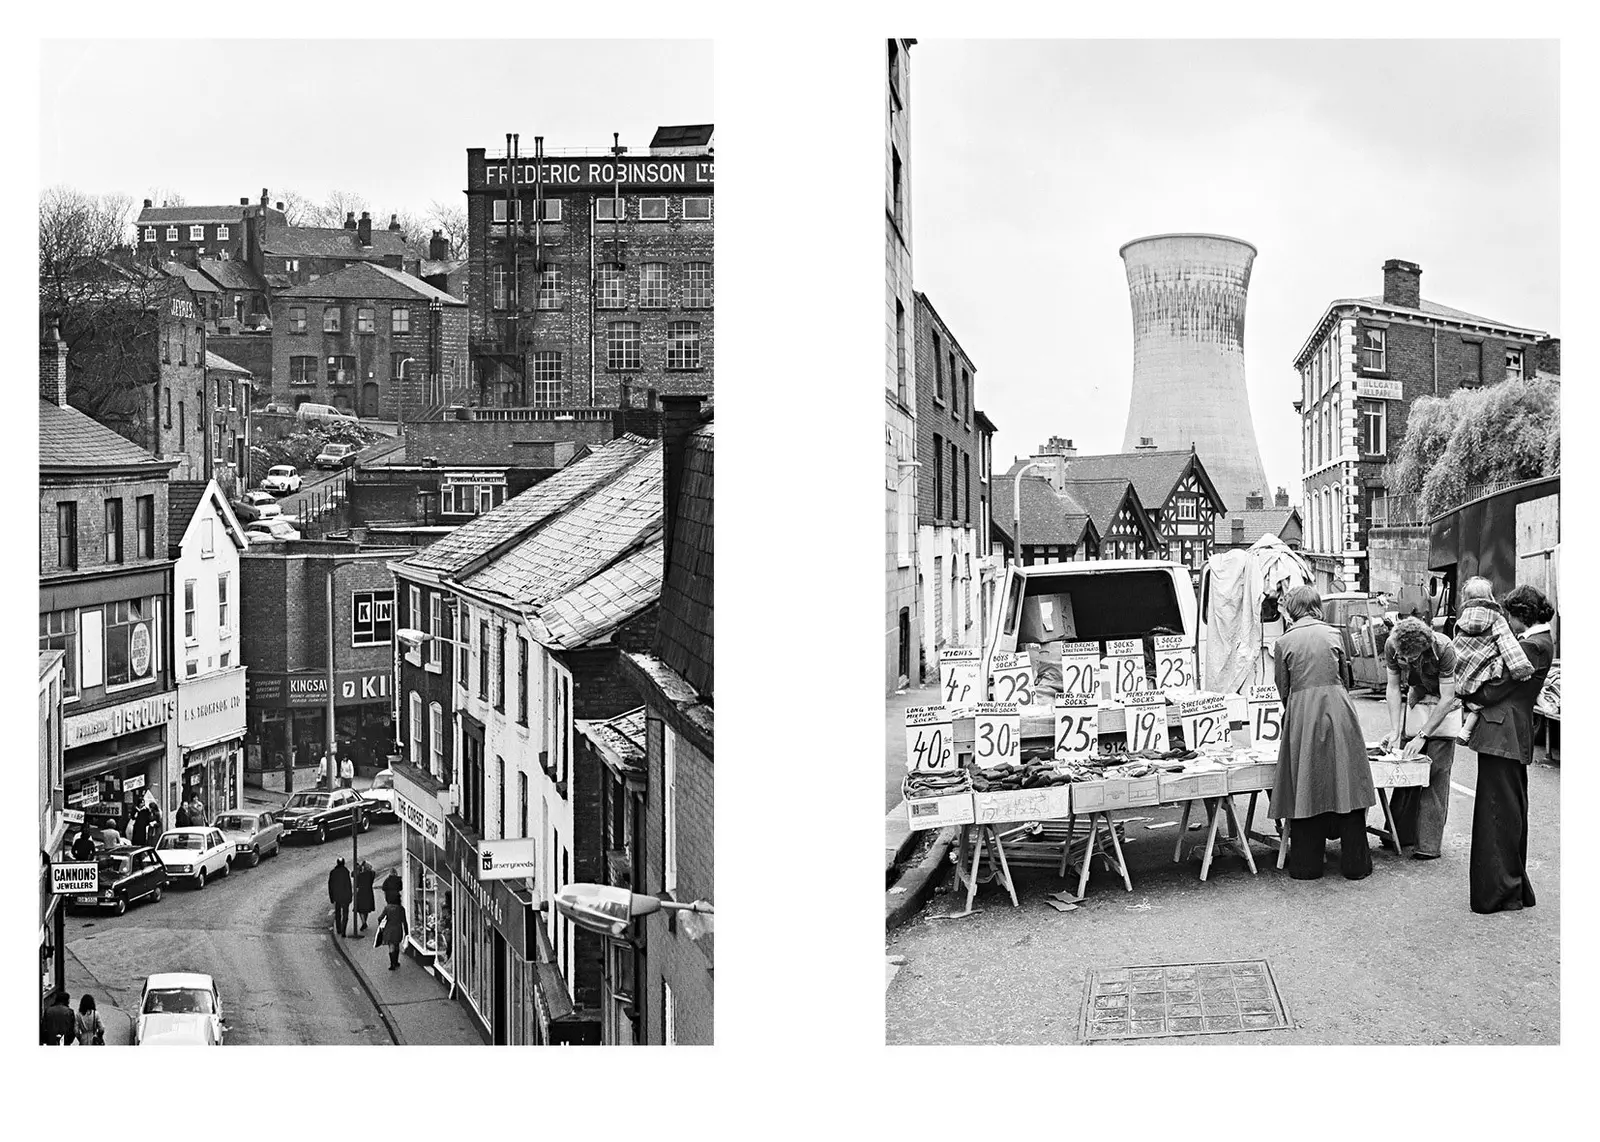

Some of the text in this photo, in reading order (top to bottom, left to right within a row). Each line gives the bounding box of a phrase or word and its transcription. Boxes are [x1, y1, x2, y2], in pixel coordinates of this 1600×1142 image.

[486, 164, 580, 184] FREDERIC
[588, 164, 685, 183] ROBINSON
[362, 675, 392, 698] KI
[112, 699, 174, 736] DISCOUNTS
[1056, 715, 1098, 753] 25p
[913, 729, 951, 769] 40p
[978, 722, 1019, 757] 30p
[407, 804, 424, 823] CORSET
[425, 818, 438, 839] SHOP
[54, 867, 96, 881] CANNONS
[56, 881, 94, 890] JEWELLERS
